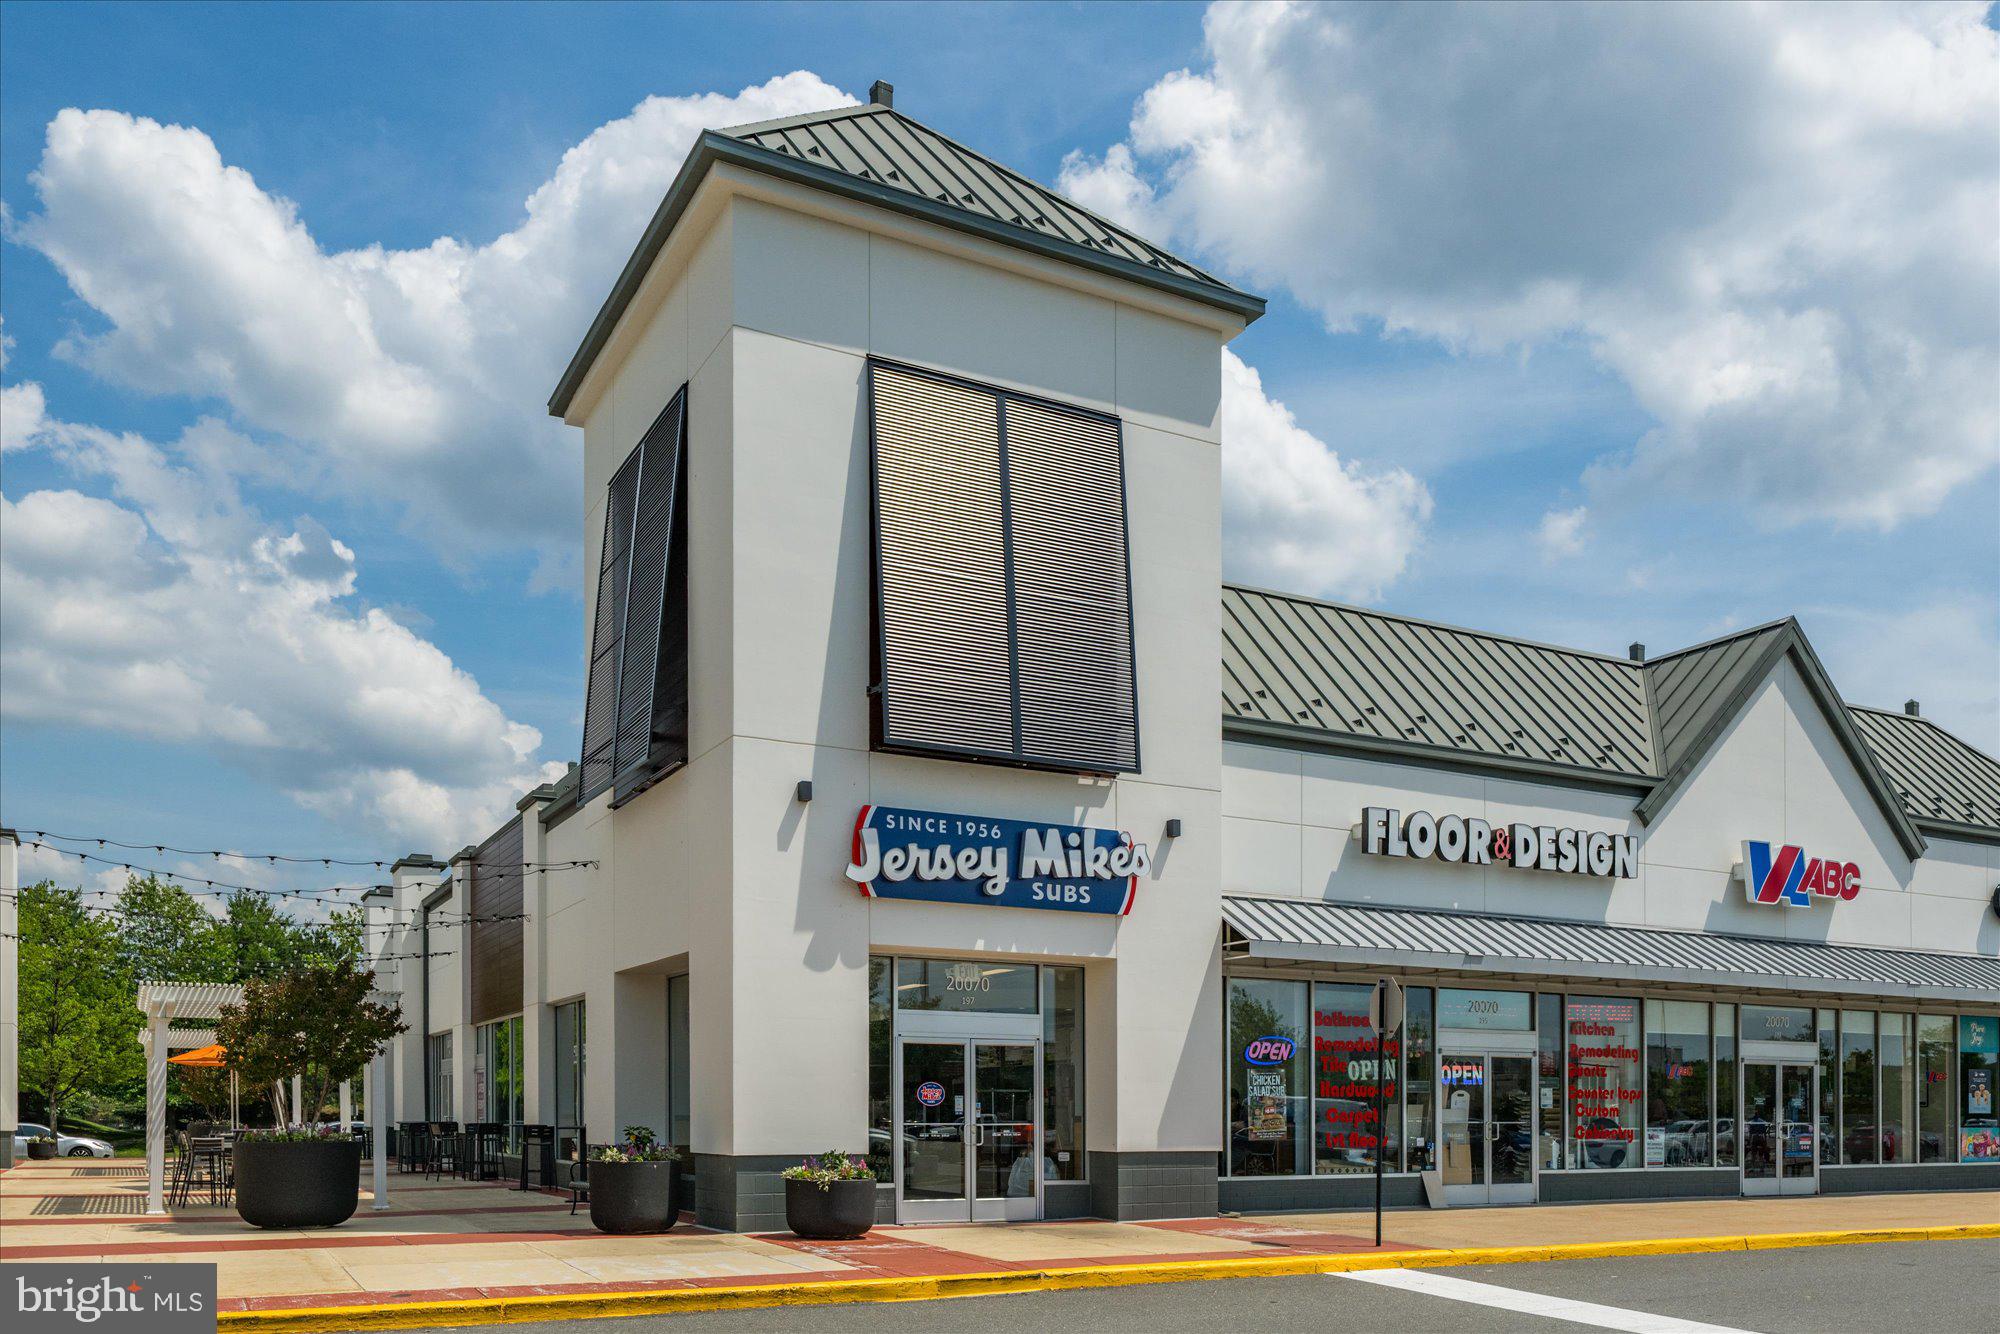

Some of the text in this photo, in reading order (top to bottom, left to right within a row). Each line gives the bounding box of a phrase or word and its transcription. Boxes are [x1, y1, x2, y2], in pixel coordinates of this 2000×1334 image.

[886, 814, 1001, 838] SINCE 1956
[1362, 807, 1492, 865] FLOOR
[1508, 823, 1639, 879] DESIGN
[846, 828, 1151, 896] Jersey Mike's
[1797, 857, 1861, 901] ABC
[1032, 882, 1091, 904] SUBS
[946, 975, 990, 992] 20070
[1468, 999, 1499, 1014] 20070
[1314, 1010, 1370, 1028] Bathroo
[1765, 1015, 1790, 1028] 20070
[1248, 1041, 1292, 1061] OPEN
[1314, 1036, 1399, 1057] Remodelng
[1568, 1043, 1639, 1063] Remodeling
[1252, 1074, 1281, 1086] CHICKEN
[1441, 1064, 1483, 1086] OPEN
[1248, 1085, 1271, 1097] SALAD
[1319, 1080, 1396, 1098] Hardwod
[1568, 1085, 1615, 1100] Counter
